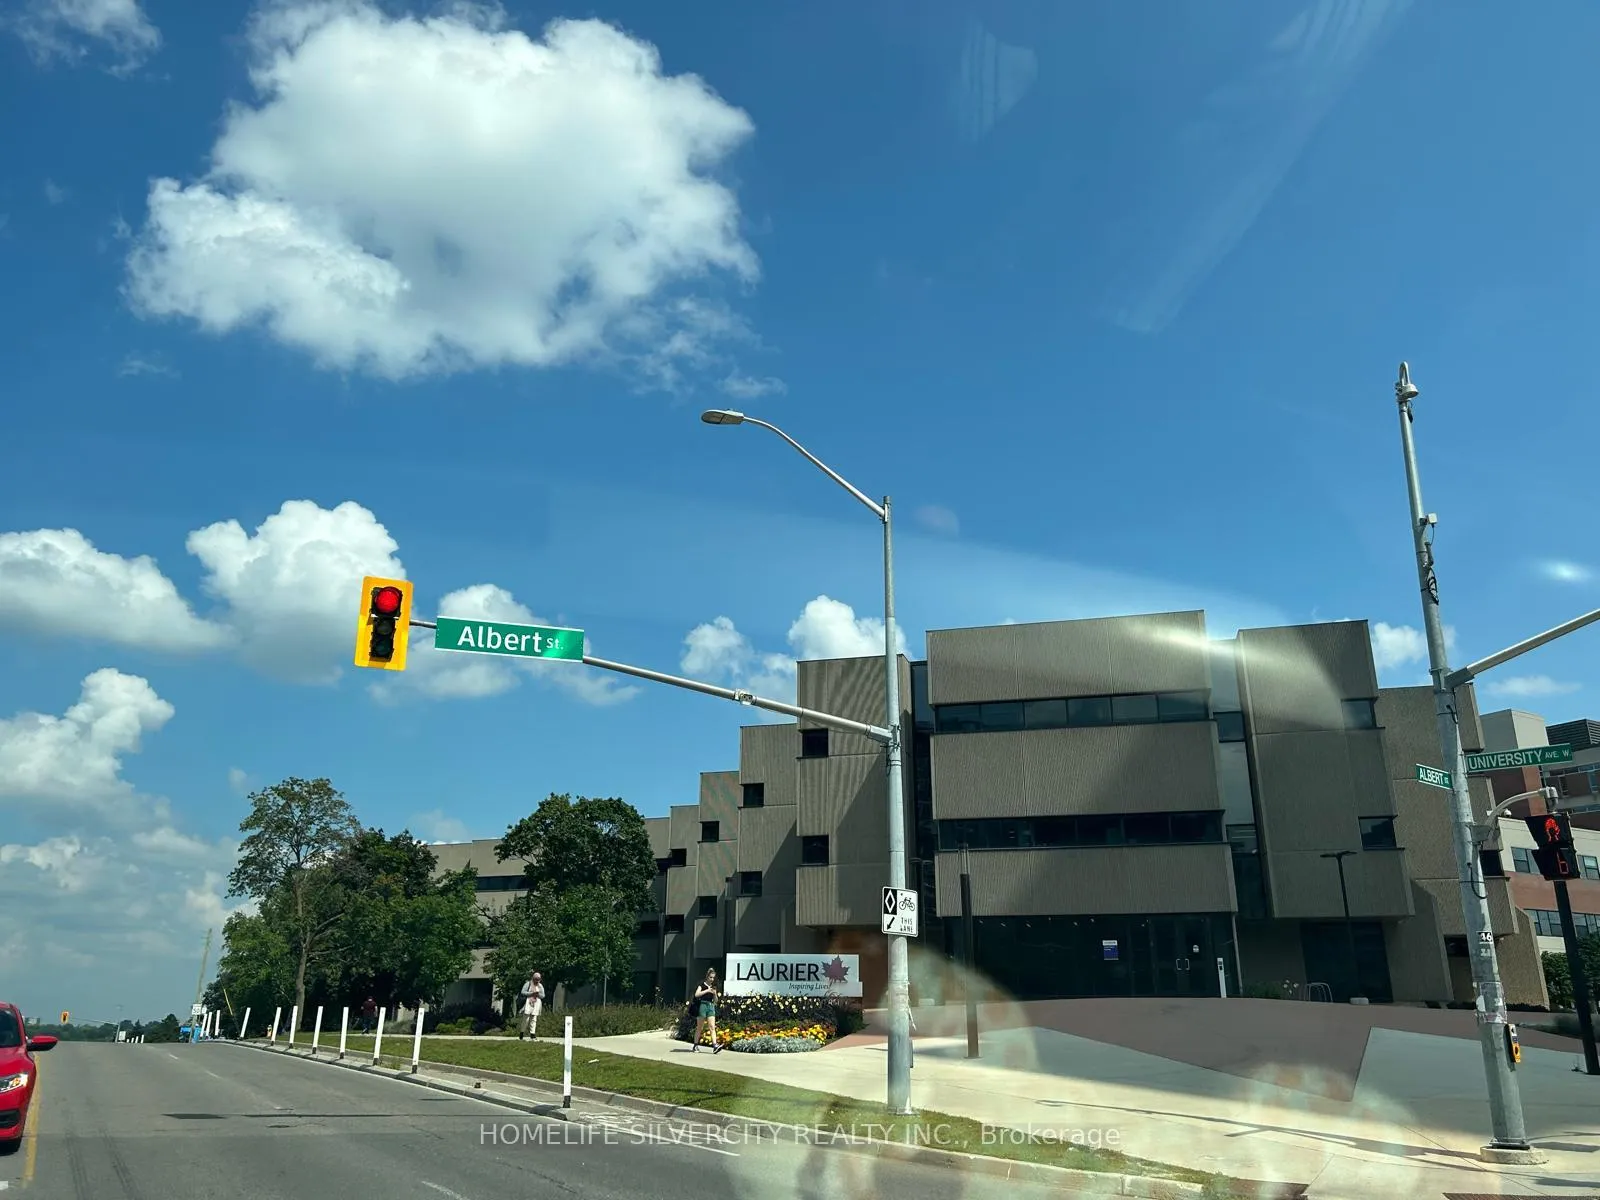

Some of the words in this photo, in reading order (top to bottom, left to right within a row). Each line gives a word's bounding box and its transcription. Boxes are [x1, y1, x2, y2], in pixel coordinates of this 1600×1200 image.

[457, 625, 542, 652] Albert
[546, 637, 564, 650] St.
[1468, 750, 1542, 769] UNIVERSITY
[1419, 767, 1444, 785] ALBERT
[901, 917, 913, 925] THIS
[736, 962, 820, 981] LAURIER
[788, 983, 814, 991] Inspiring
